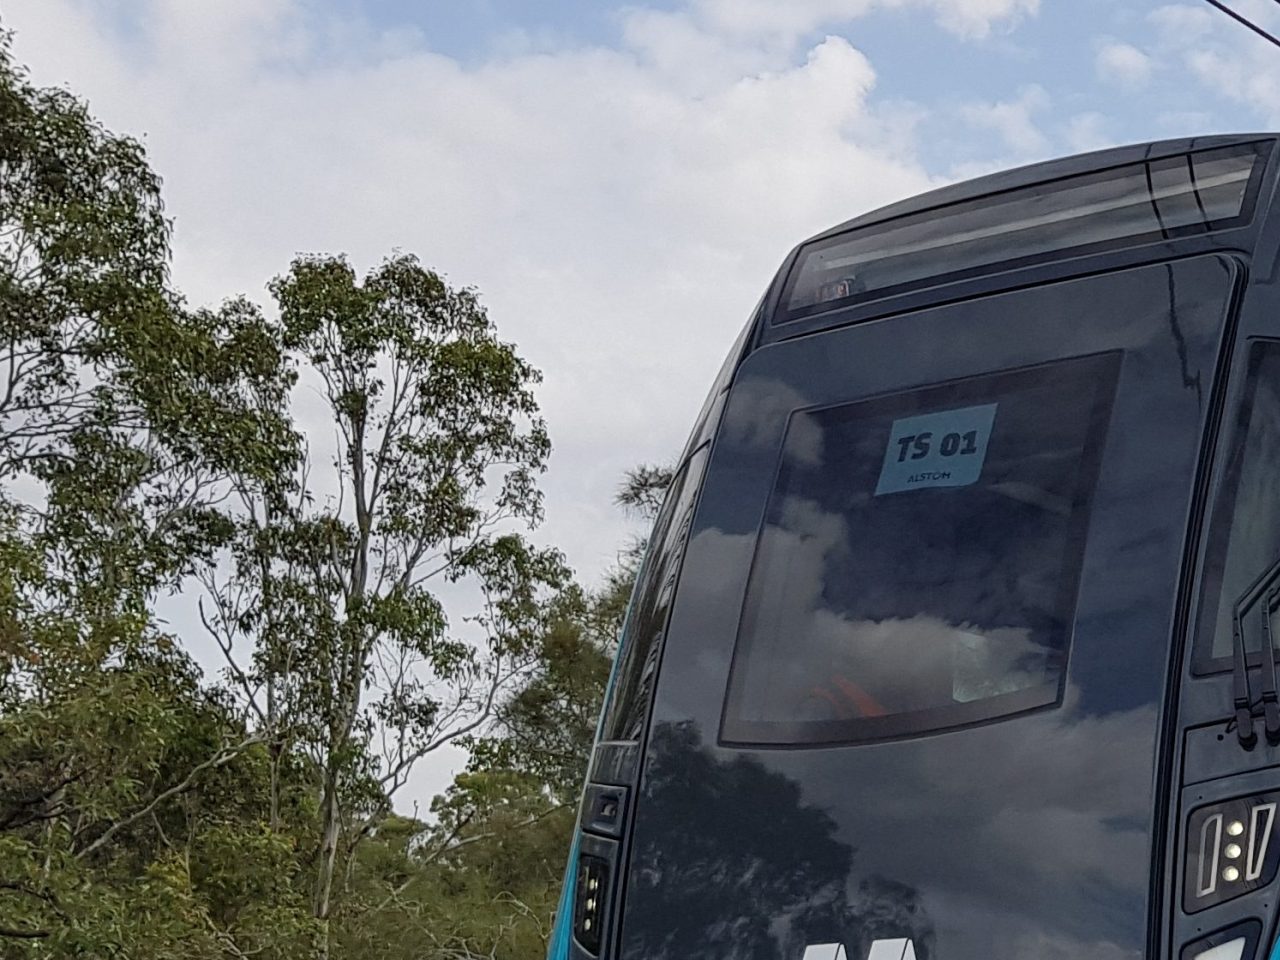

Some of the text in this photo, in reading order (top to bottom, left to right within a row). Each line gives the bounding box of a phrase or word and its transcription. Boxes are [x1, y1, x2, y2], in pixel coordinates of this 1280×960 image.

[897, 430, 977, 462] TS 01
[907, 471, 951, 483] ALSTOM
